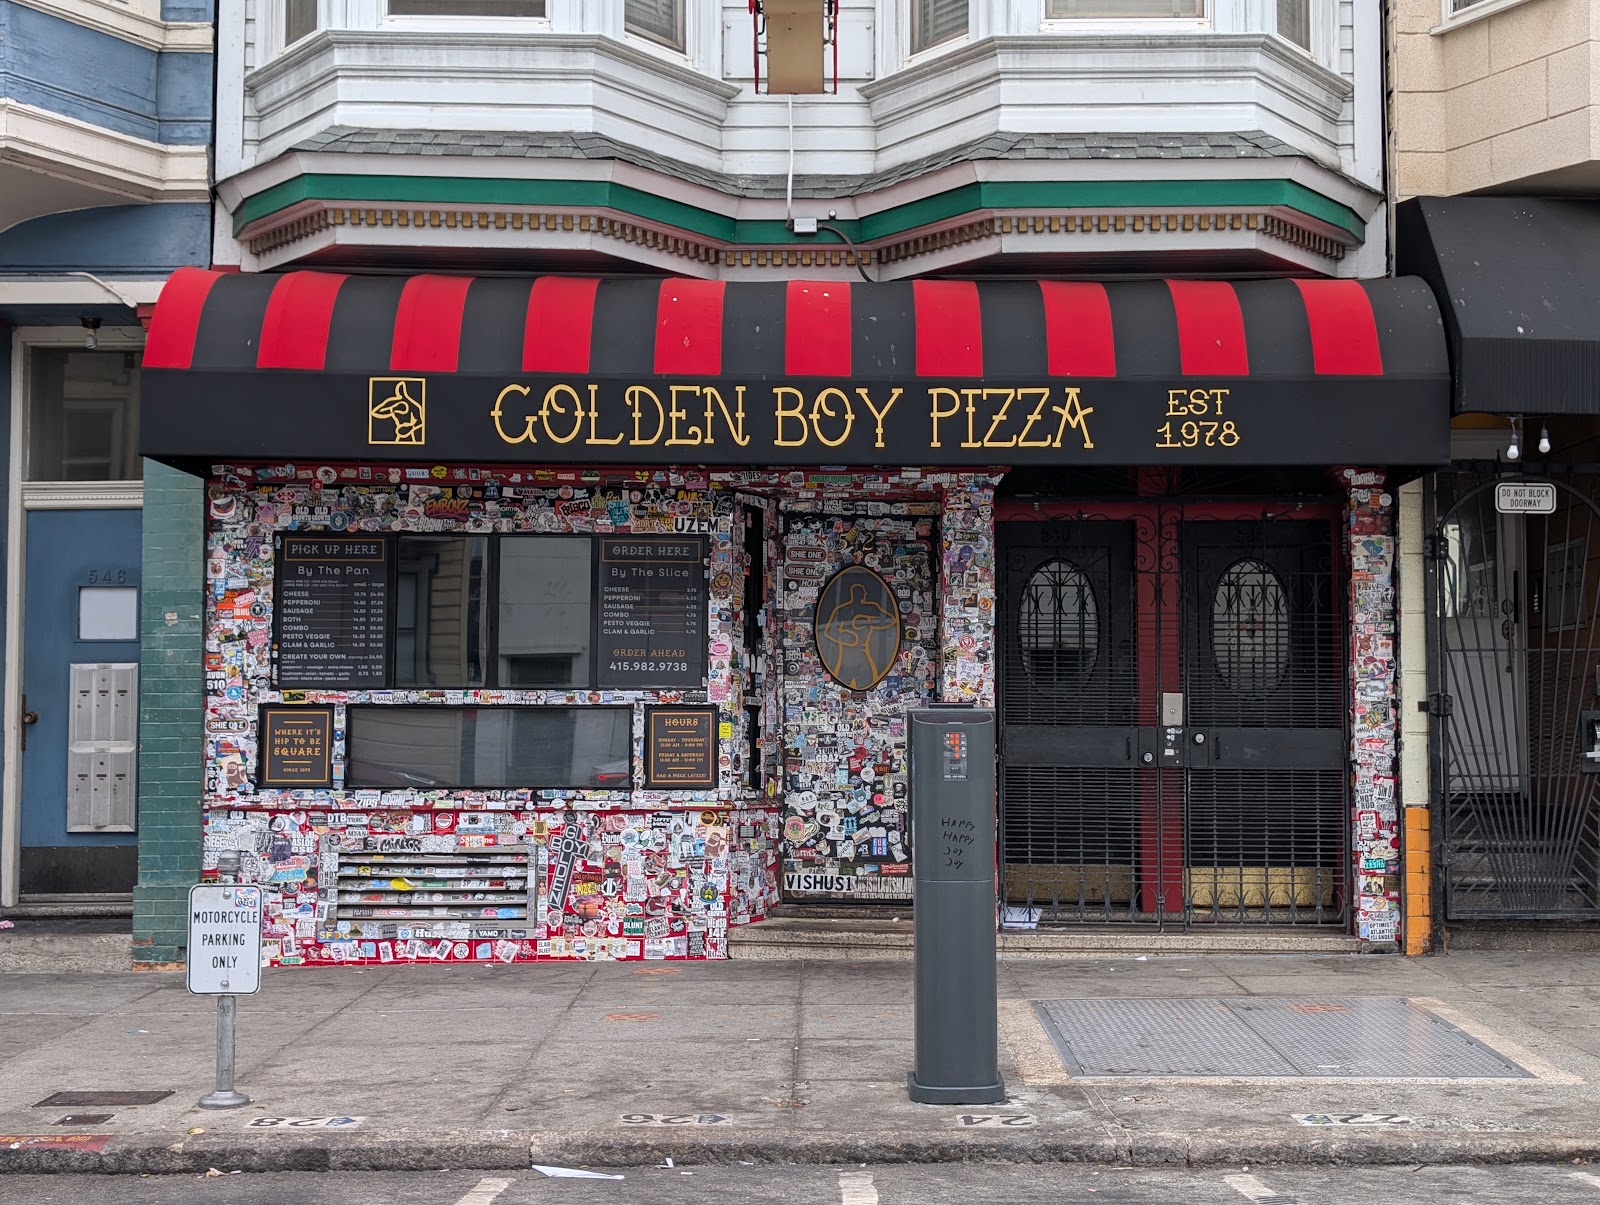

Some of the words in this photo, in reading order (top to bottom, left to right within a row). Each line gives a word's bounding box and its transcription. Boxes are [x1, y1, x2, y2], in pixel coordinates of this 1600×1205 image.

[1165, 389, 1229, 416] EST
[491, 384, 750, 446] GOLDEN
[773, 386, 903, 448] BOY
[928, 387, 1094, 449] PIZZA
[1156, 420, 1240, 448] 1978
[1502, 489, 1510, 497] DO
[1514, 489, 1526, 497] NOT
[1529, 489, 1550, 498] BLOCK
[1510, 499, 1541, 508] DOORWAY
[291, 544, 320, 554] PICK
[325, 545, 340, 554] UP
[345, 545, 377, 555] HERE
[612, 546, 653, 556] ORDER
[658, 546, 690, 556] HERE
[808, 551, 823, 559] ONE
[88, 569, 127, 584] 546
[298, 566, 313, 577] By
[318, 566, 340, 575] The
[346, 566, 370, 575] Pan
[612, 567, 626, 578] By
[632, 568, 653, 577] The
[658, 568, 689, 577] Slice
[613, 648, 647, 657] ORDER
[650, 649, 686, 657] AHEAD
[609, 661, 688, 671] 415.982.9738
[665, 718, 698, 726] HOURS
[305, 728, 321, 736] IT'S
[273, 747, 321, 756] SQUARE
[328, 813, 347, 822] DTB
[193, 911, 258, 923] MOTORCYCLE
[202, 934, 245, 946] PARKING
[212, 956, 238, 968] ONLY
